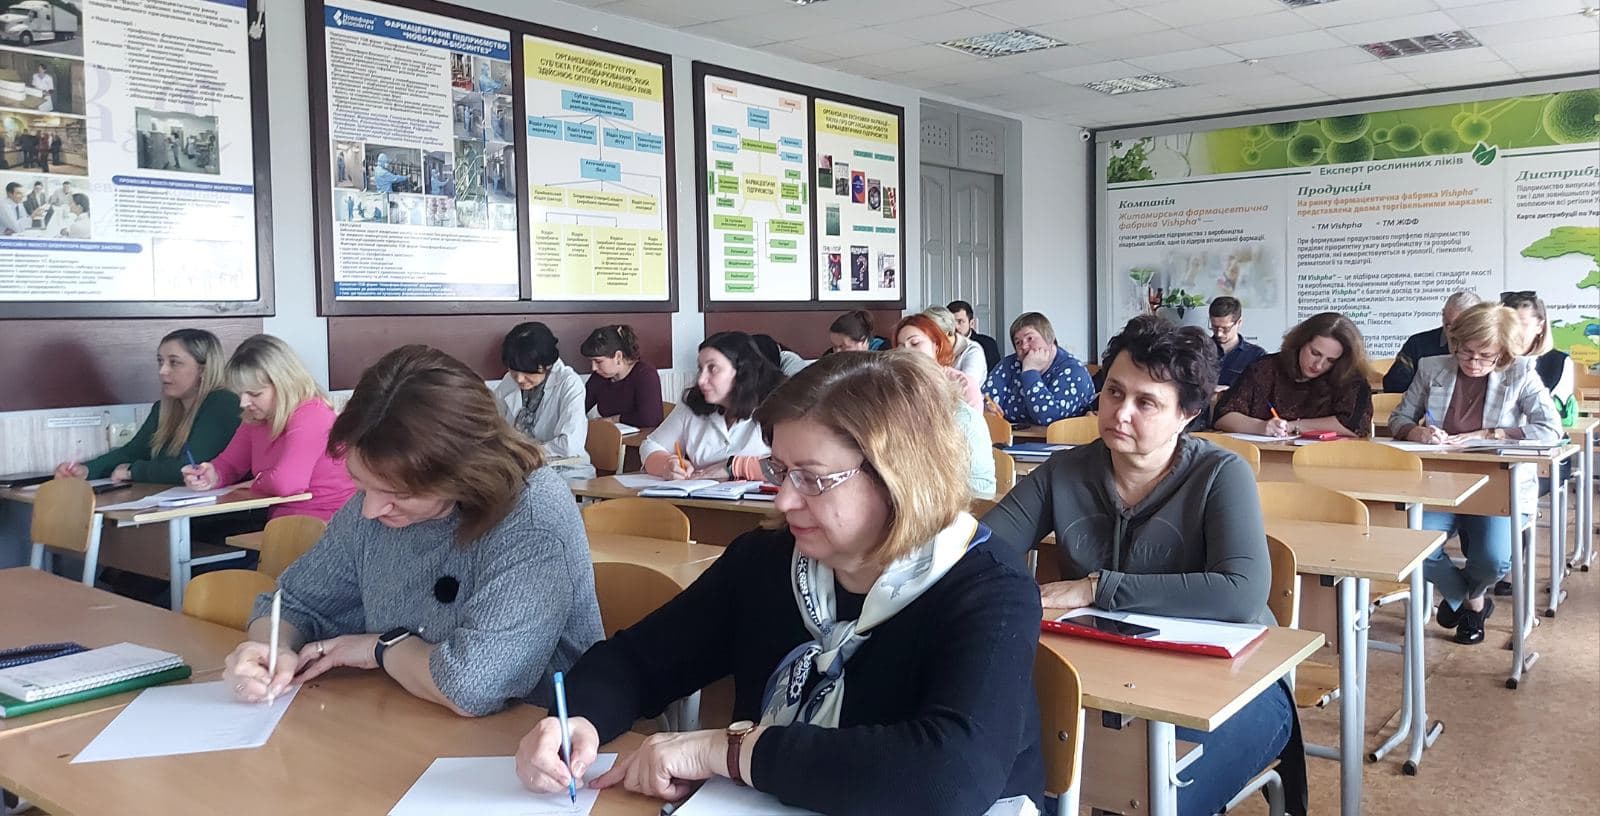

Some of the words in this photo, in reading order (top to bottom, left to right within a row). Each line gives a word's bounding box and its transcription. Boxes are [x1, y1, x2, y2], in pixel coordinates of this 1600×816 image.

[343, 13, 375, 24] Новофарм
[384, 20, 451, 39] ФАРМАЦЕВТИЧНЕ
[452, 34, 507, 50] ПІДПРИЄМСТВО
[1320, 166, 1364, 176] Експерт
[1367, 160, 1432, 174] рослинних
[1434, 156, 1464, 166] ліків
[1297, 182, 1372, 197] Продукція
[1517, 184, 1564, 192] Підприємство
[1565, 182, 1595, 190] випускає
[1119, 197, 1176, 208] Компанія
[1298, 199, 1307, 207] На
[1309, 199, 1332, 208] ринку
[1334, 194, 1400, 206] фармацевтична
[1401, 192, 1439, 200] фабрика
[1567, 198, 1592, 206] регіони
[1119, 210, 1184, 220] Житомирська
[1186, 205, 1268, 216] фармацевтична
[1297, 206, 1352, 216] представлена
[1354, 205, 1380, 213] двома
[1382, 200, 1446, 212] торгівельними
[1448, 198, 1492, 208] марками:
[1537, 210, 1578, 219] дистрибуції
[1118, 221, 1158, 230] фабрика
[1330, 221, 1362, 230] Vishpha
[1396, 218, 1419, 226] ЖФФ
[1347, 234, 1389, 242] продуктового
[1390, 232, 1422, 240] портфелю
[1424, 230, 1470, 239] підприємство
[1380, 240, 1422, 248] виробництву
[1432, 238, 1462, 247] розробці
[1343, 250, 1400, 258] використовуються
[1406, 248, 1434, 256] урології,
[1436, 246, 1473, 254] гінекології,
[1297, 260, 1335, 268] ревматології
[1380, 272, 1412, 280] сировина,
[1436, 270, 1470, 279] стандарти
[1471, 268, 1492, 276] якості
[1436, 278, 1466, 286] розробці
